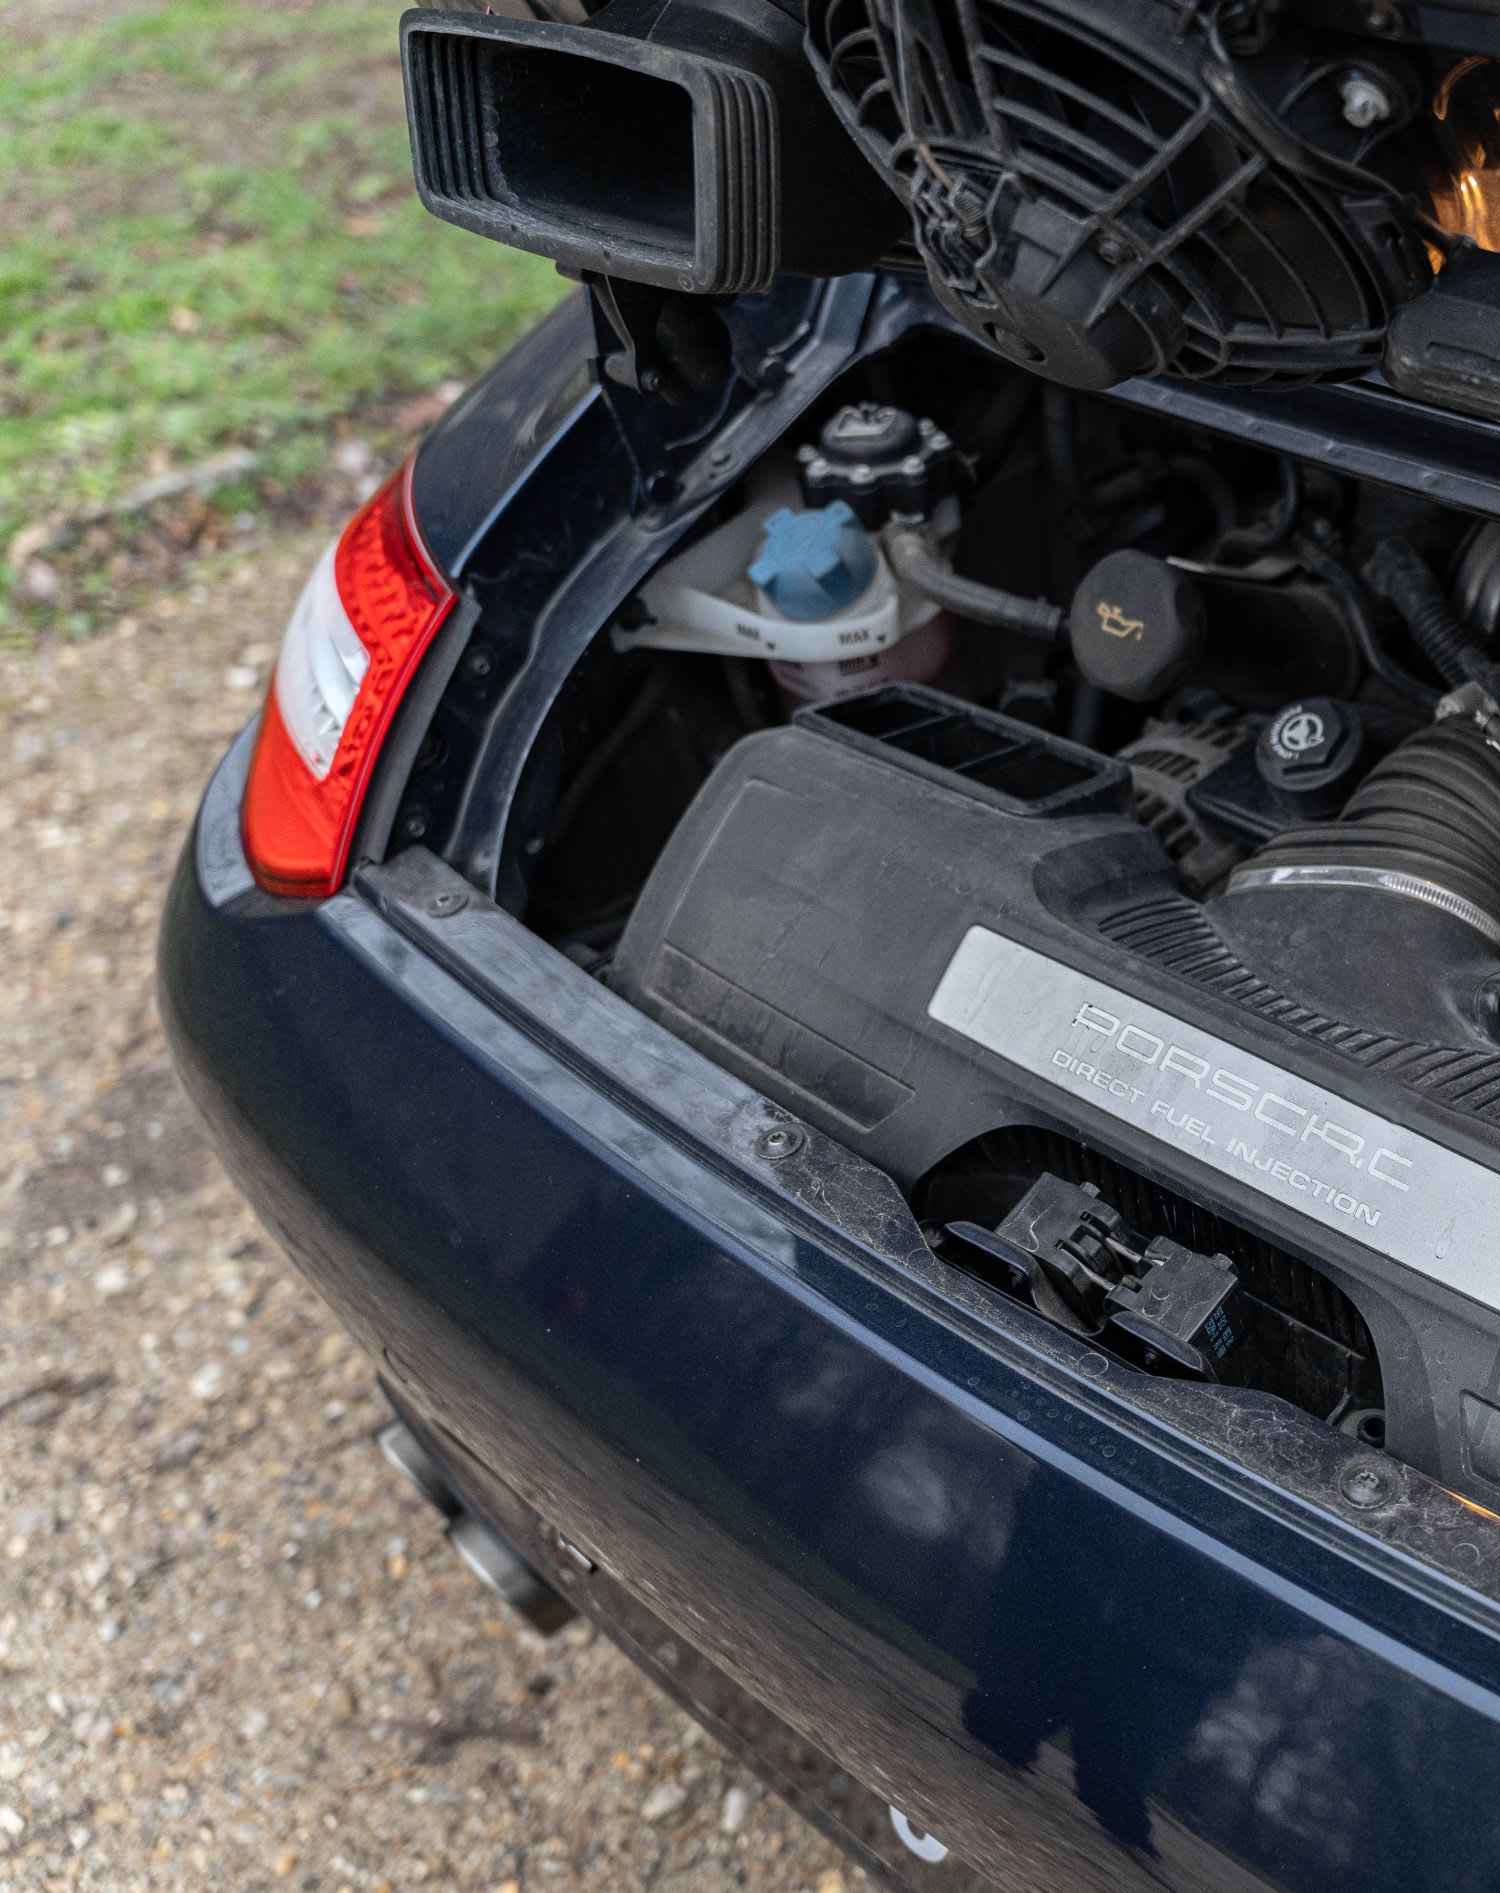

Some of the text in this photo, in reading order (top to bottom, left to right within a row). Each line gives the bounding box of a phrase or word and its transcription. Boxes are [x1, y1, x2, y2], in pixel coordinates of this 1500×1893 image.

[839, 628, 870, 645] MAX
[1052, 1049, 1383, 1228] DIRECT FUEL INJECTION
